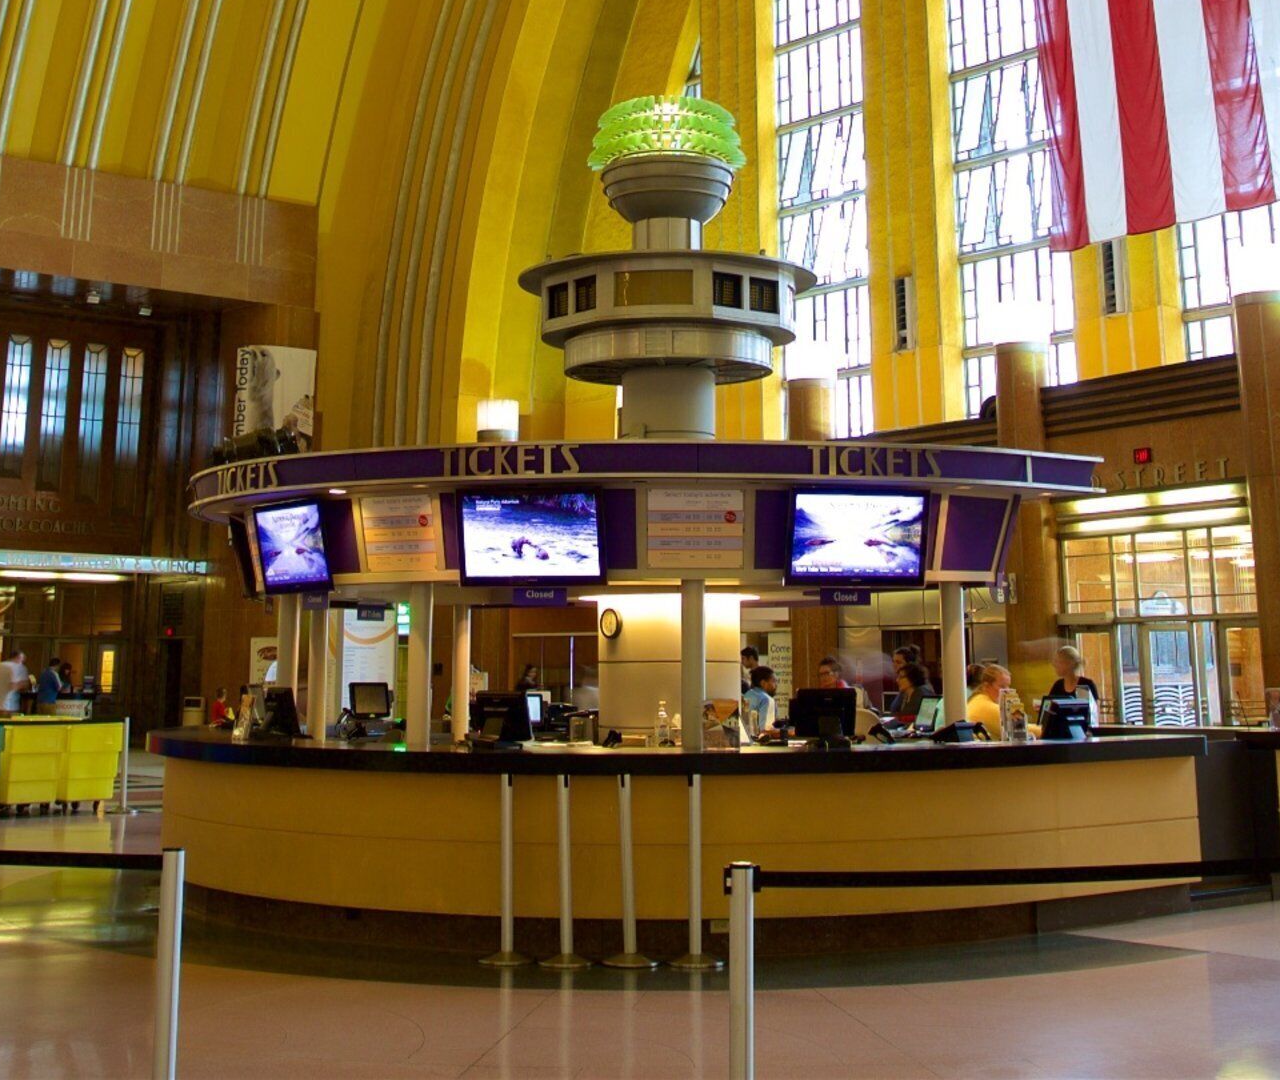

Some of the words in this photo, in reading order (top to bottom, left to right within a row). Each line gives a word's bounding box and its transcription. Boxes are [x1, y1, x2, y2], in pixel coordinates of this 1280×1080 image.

[235, 349, 252, 393] Today
[439, 444, 581, 478] TICKETS
[807, 445, 943, 478] TICKETS
[1115, 457, 1230, 490] STREET
[216, 460, 279, 496] TICKETS
[28, 519, 97, 536] COACHES
[150, 558, 202, 574] SCIENCE
[525, 590, 555, 600] Closed
[832, 591, 858, 602] Closed
[770, 643, 791, 653] Come
